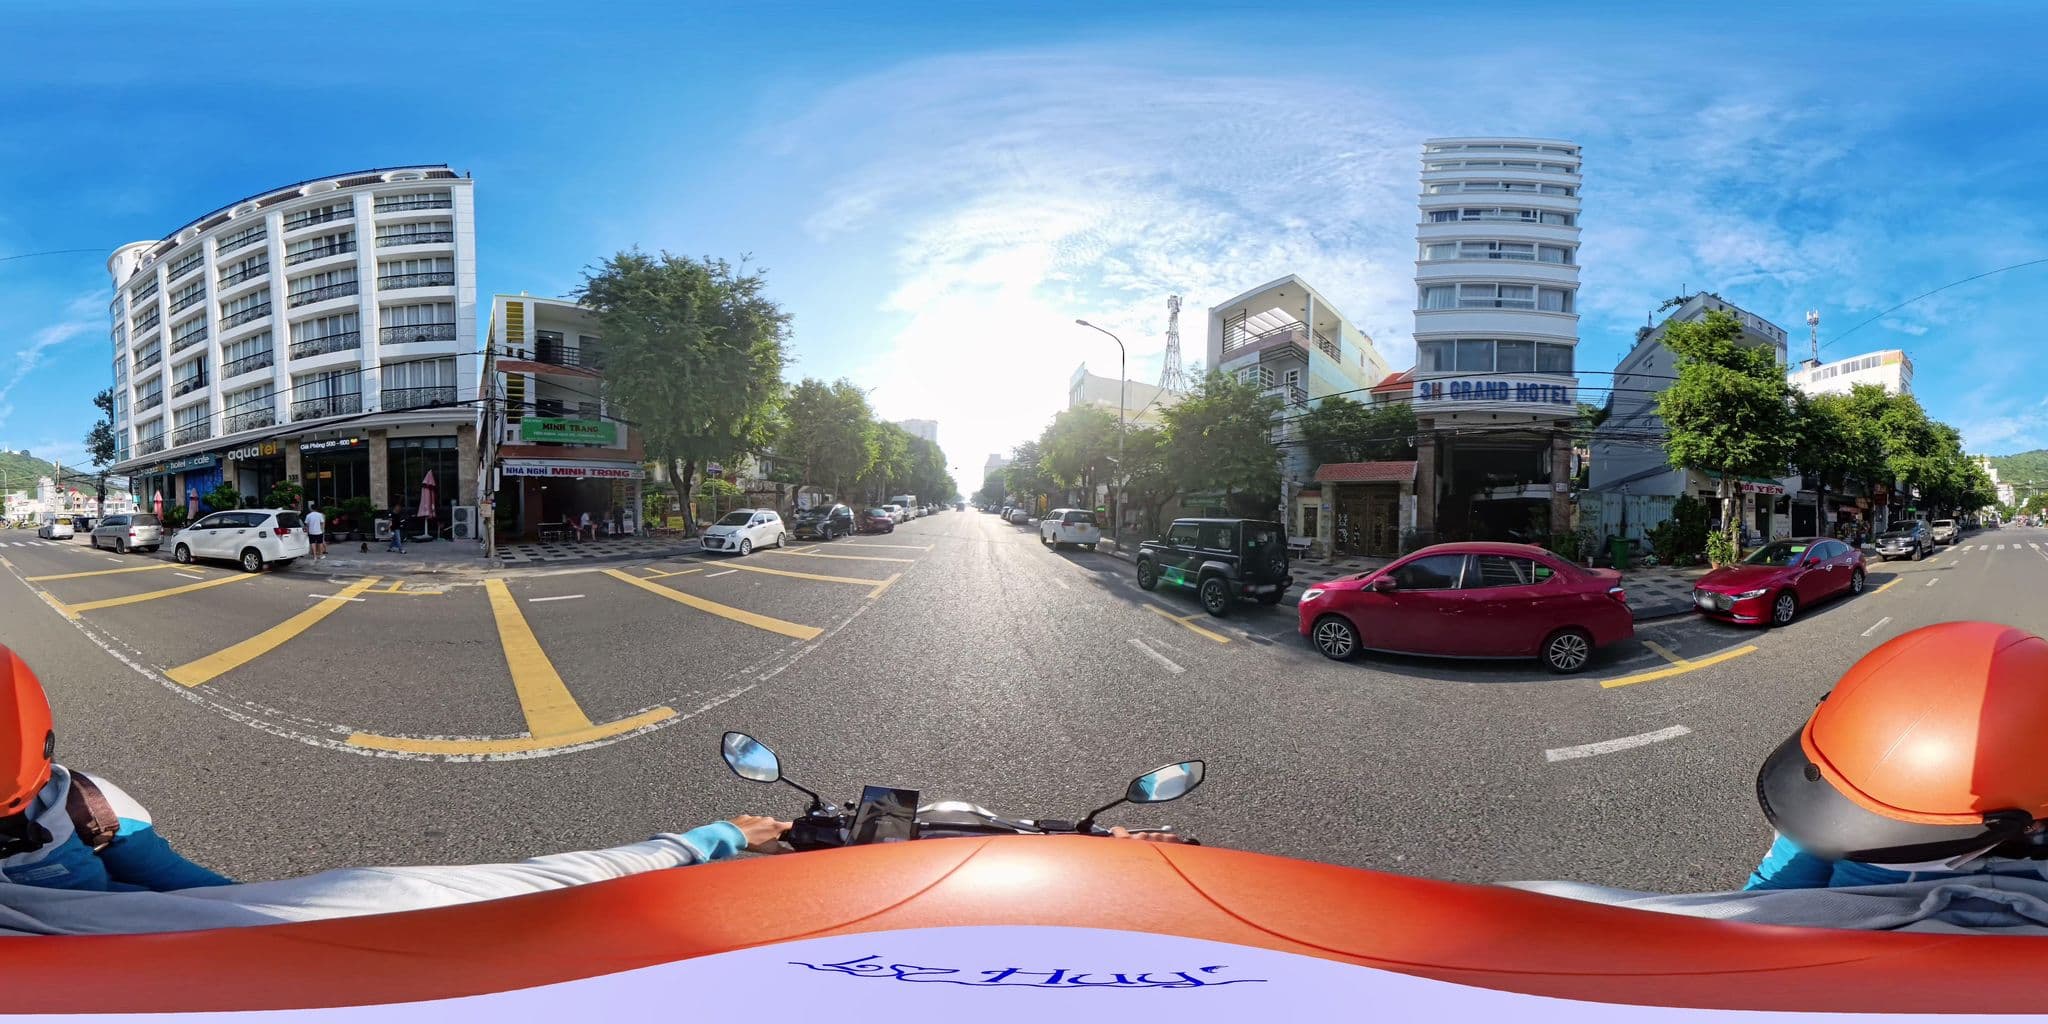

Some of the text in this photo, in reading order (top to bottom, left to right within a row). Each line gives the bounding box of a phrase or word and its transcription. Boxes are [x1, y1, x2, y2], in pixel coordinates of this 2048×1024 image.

[1420, 381, 1571, 405] 3H GRAND HOTEL
[543, 422, 599, 432] MINH TRANG
[227, 440, 277, 461] aquatel
[171, 459, 186, 469] hotel
[551, 467, 586, 476] MINH
[591, 468, 630, 477] TRANG
